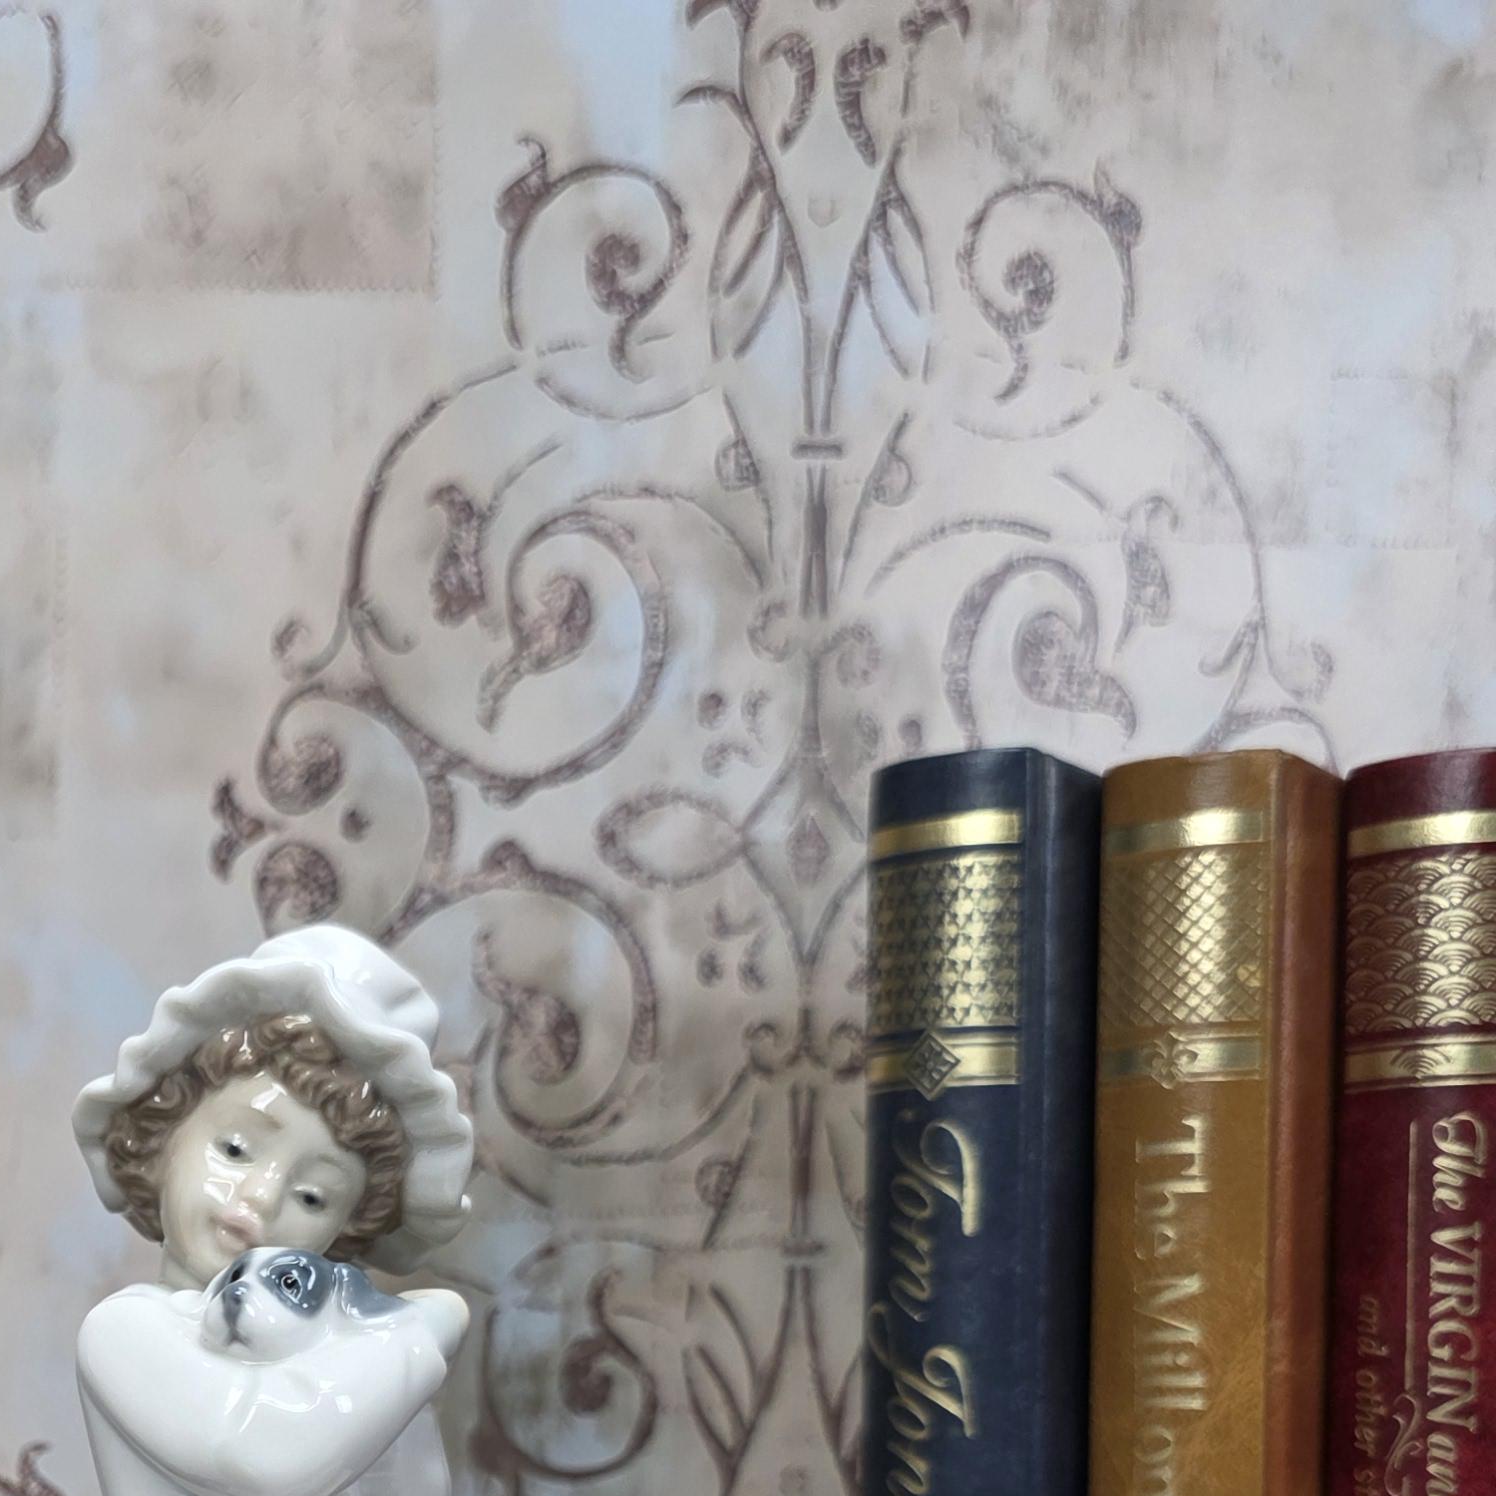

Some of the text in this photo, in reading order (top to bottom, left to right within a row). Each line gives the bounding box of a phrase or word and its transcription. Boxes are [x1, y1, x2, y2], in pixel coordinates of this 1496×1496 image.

[890, 1109, 981, 1322] Tom
[1134, 1114, 1212, 1261] The
[1432, 1109, 1487, 1213] The
[1134, 1273, 1208, 1412] Mill
[1354, 1296, 1391, 1358] and
[1427, 1221, 1484, 1434] VIRGIN
[1353, 1369, 1389, 1458] other
